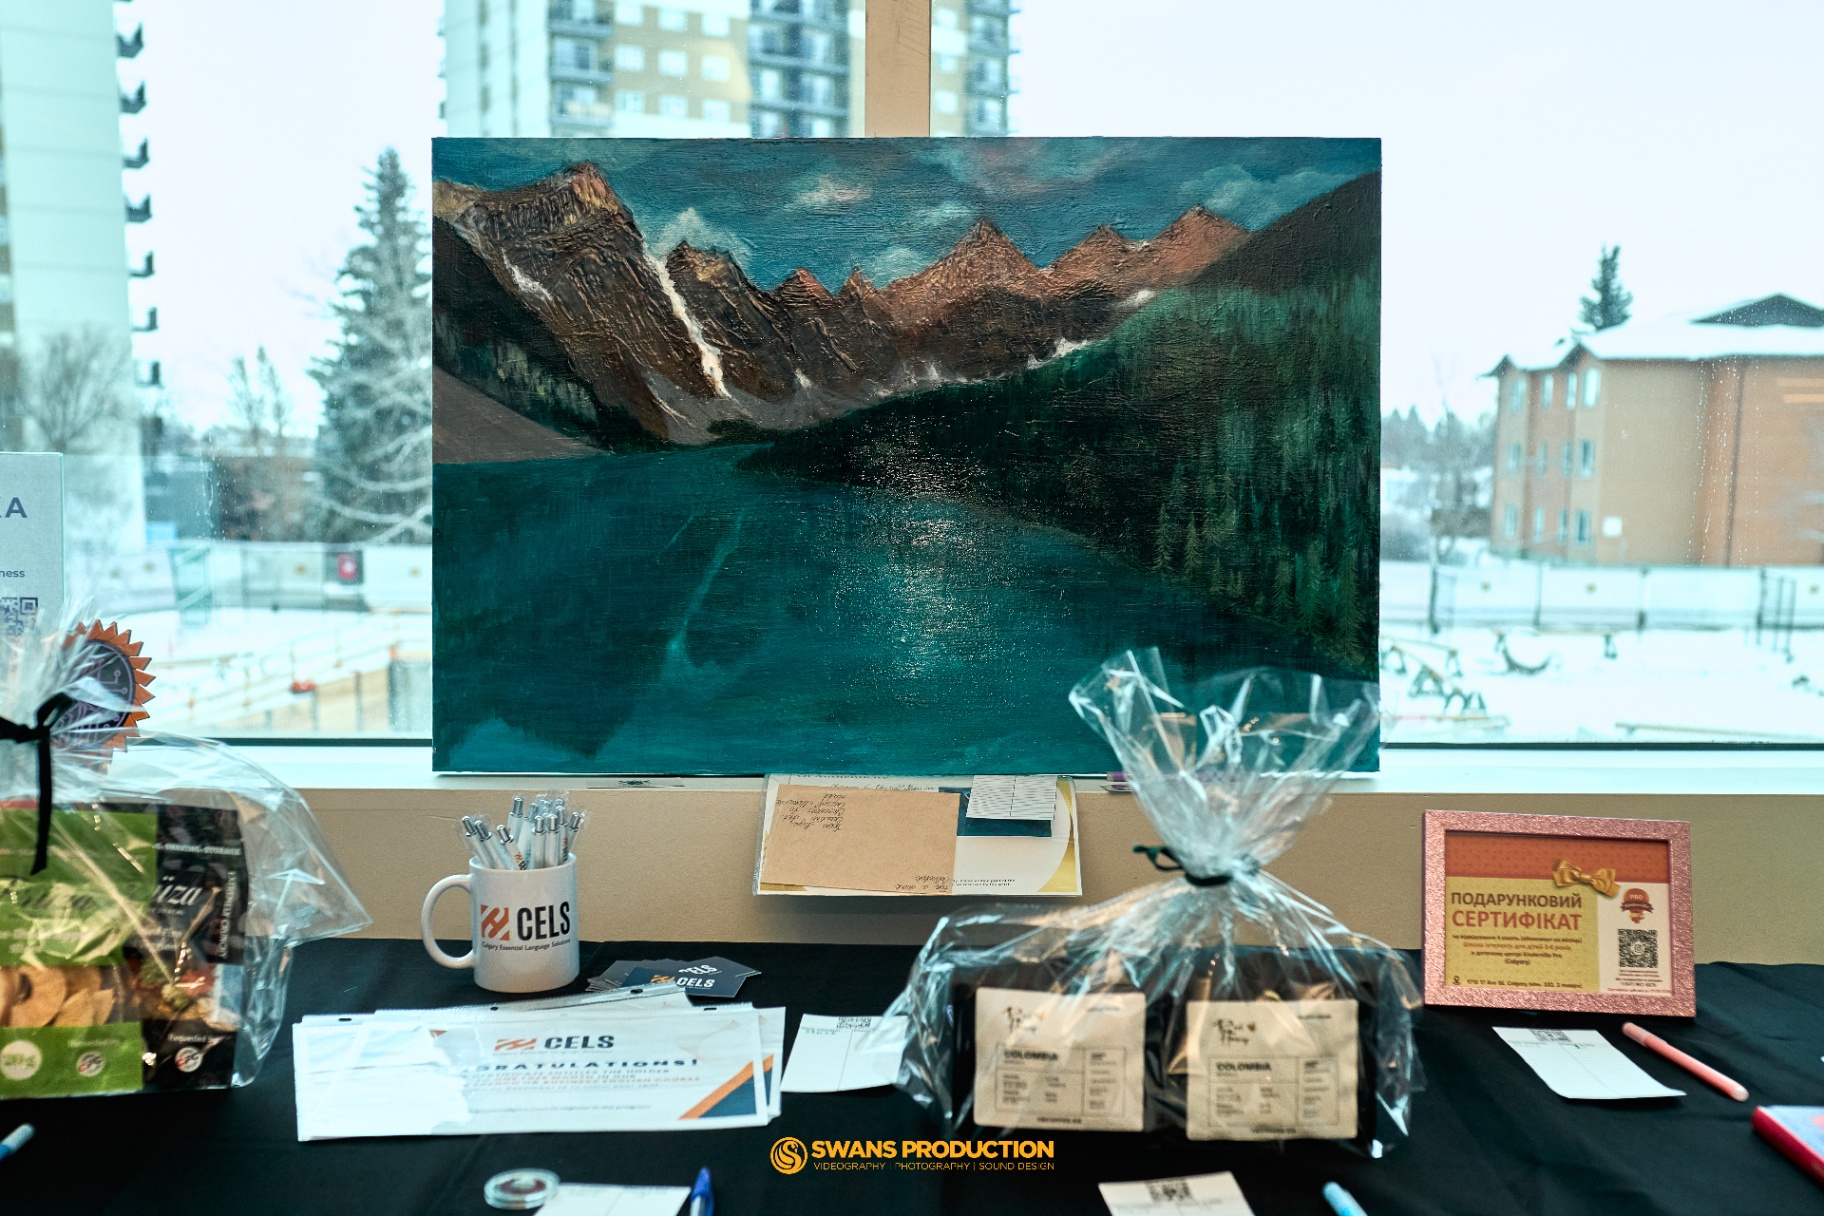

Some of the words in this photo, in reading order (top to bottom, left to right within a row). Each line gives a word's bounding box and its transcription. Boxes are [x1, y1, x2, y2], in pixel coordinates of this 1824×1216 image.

[0, 496, 28, 519] A
[1451, 892, 1582, 908] ПОДАРУНКОВИЙ
[517, 901, 571, 942] CELS
[1452, 910, 1582, 930] СЕРТИФІКАТ
[525, 943, 550, 952] Language
[676, 976, 717, 988] CELS
[543, 1035, 616, 1050] CELS
[1216, 1061, 1272, 1072] COLOMBIA
